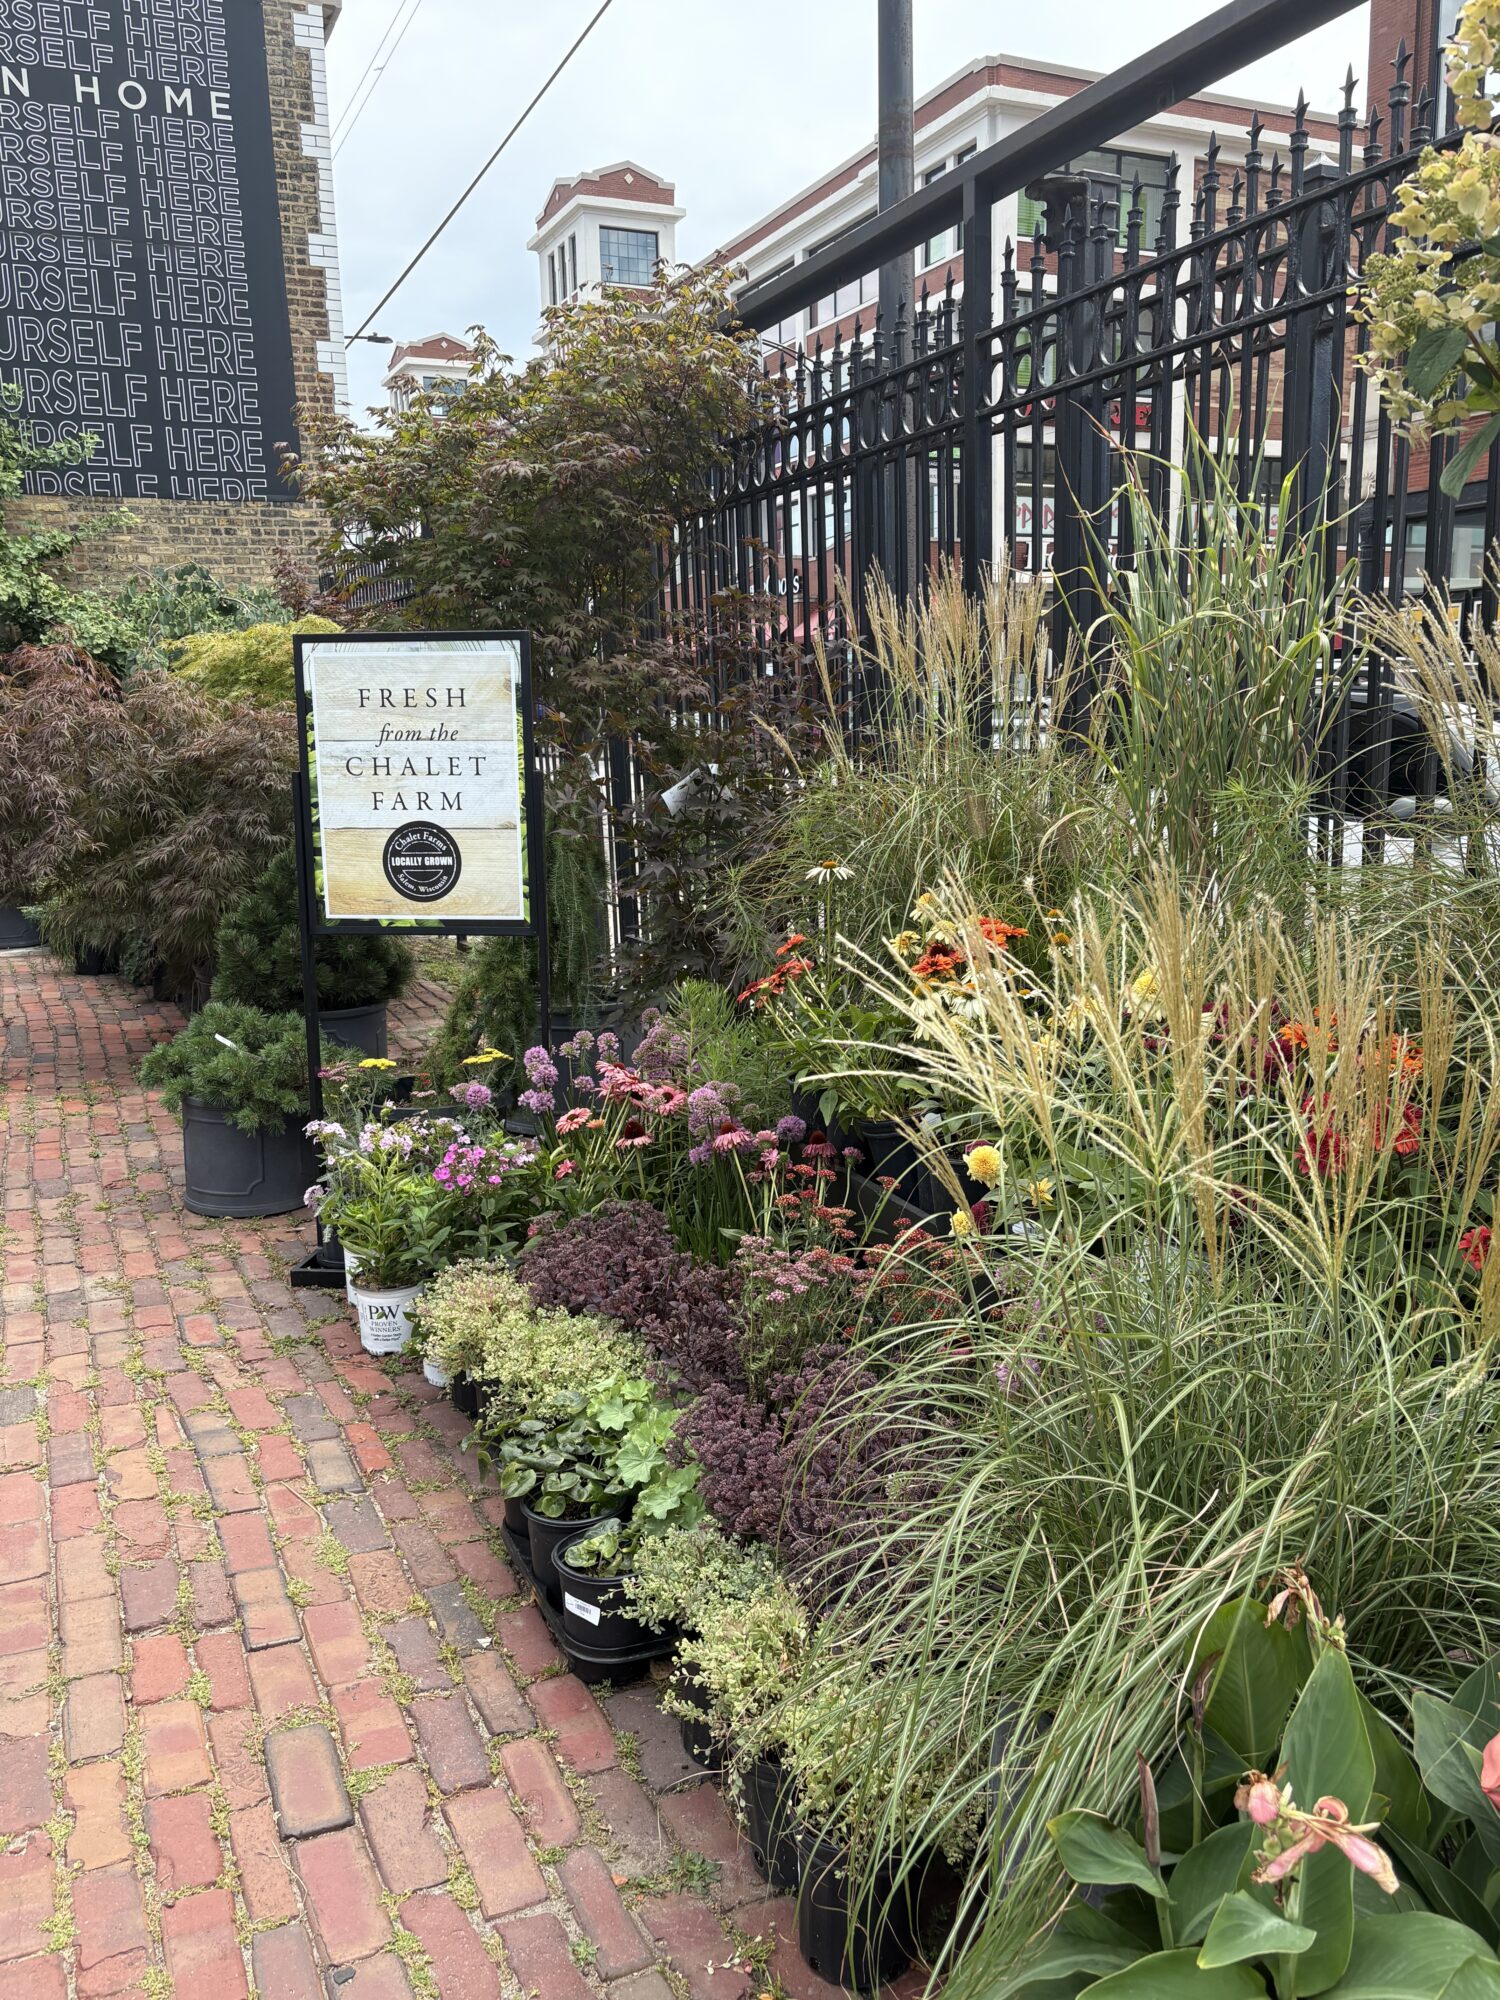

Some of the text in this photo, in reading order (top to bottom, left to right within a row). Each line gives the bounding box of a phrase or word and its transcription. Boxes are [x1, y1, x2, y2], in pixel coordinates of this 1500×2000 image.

[124, 14, 228, 58] HERE
[127, 47, 231, 90] HERE
[74, 73, 232, 121] HOME
[133, 113, 236, 153] HERE
[136, 145, 239, 185] HERE
[1, 164, 242, 217] RSELF HERE
[0, 197, 245, 249] RSELF HERE
[146, 241, 248, 280] HERE
[149, 274, 252, 327] HERE
[154, 325, 257, 376] HERE
[160, 376, 262, 425] HERE
[165, 426, 266, 473] HERE
[357, 687, 467, 709] FRESH
[375, 722, 459, 748] from the
[345, 756, 487, 777] CHALET
[371, 791, 463, 811] FARM
[391, 856, 453, 867] LOCALLY GROWN
[394, 831, 448, 852] Chalet Farms
[397, 873, 449, 893] Salem, Wisconsin
